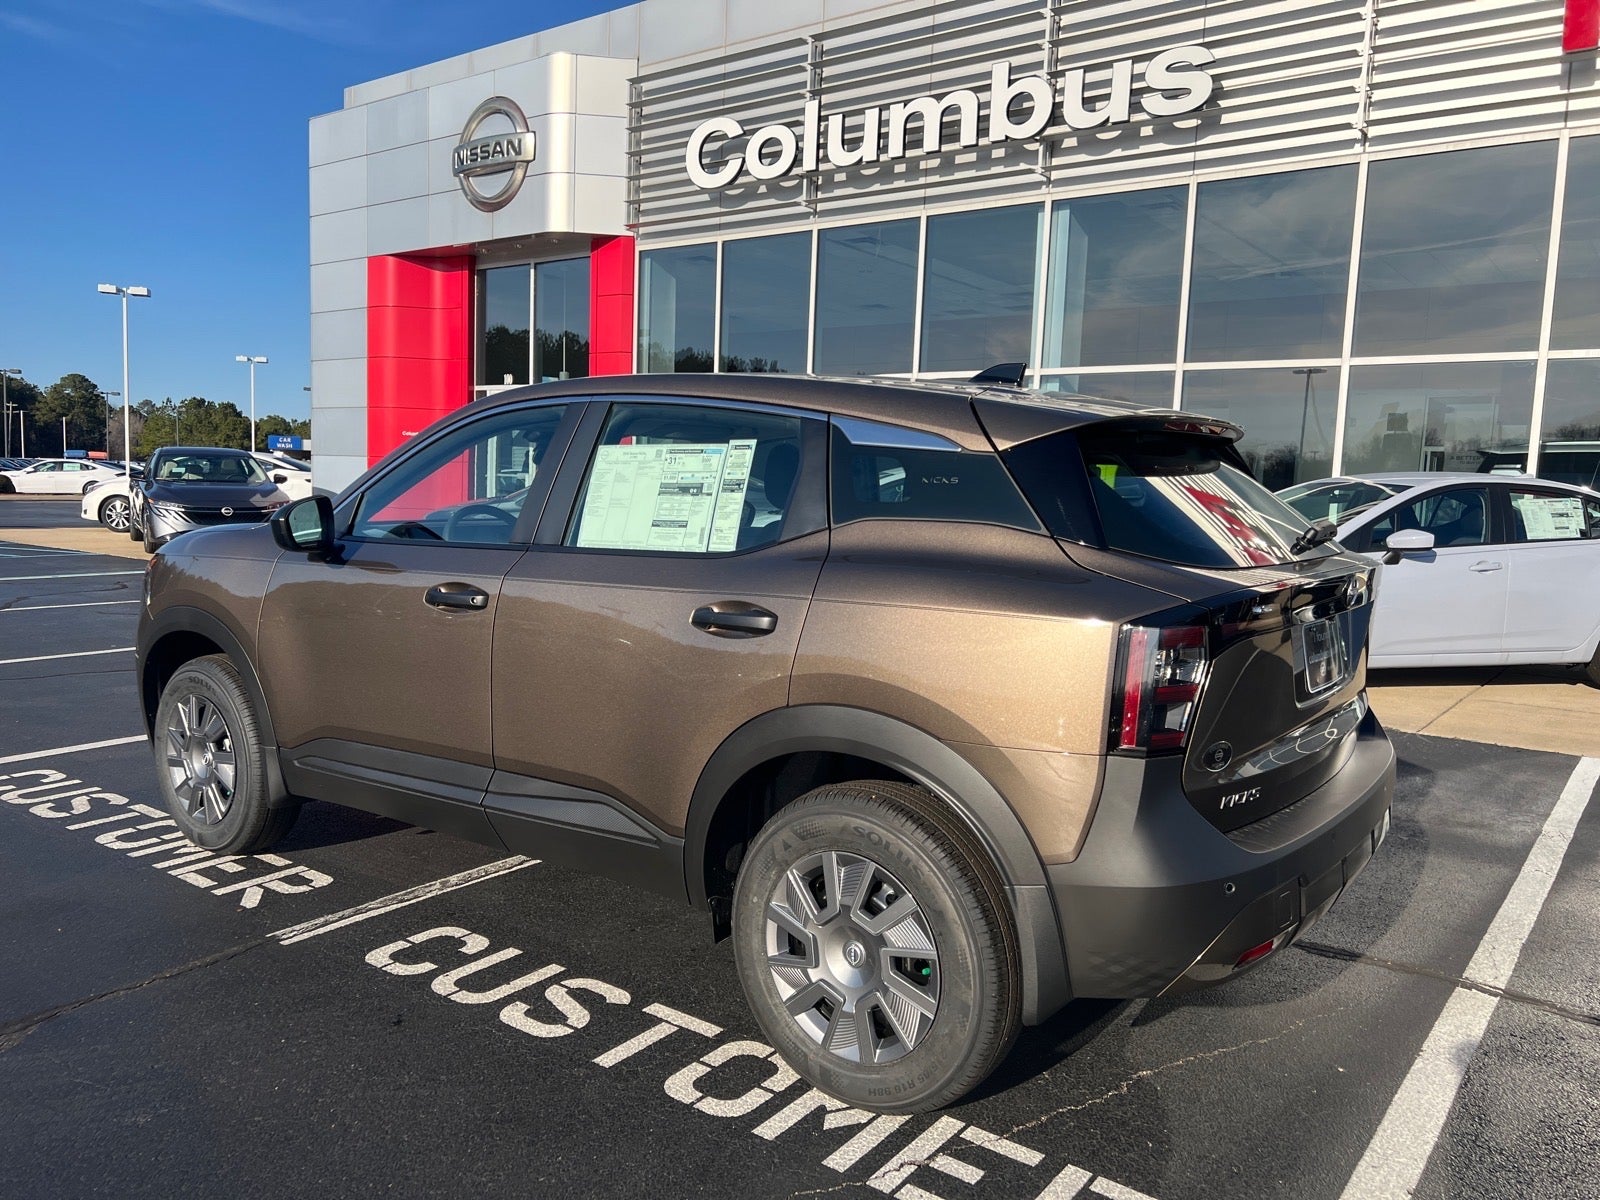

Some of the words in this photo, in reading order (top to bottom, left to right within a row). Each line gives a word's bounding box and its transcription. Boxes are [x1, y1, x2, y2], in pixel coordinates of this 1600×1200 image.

[454, 138, 522, 169] NISSAN
[684, 45, 1216, 189] Columbus
[0, 769, 334, 909] CUSTOMER
[852, 825, 925, 880] SOLUS
